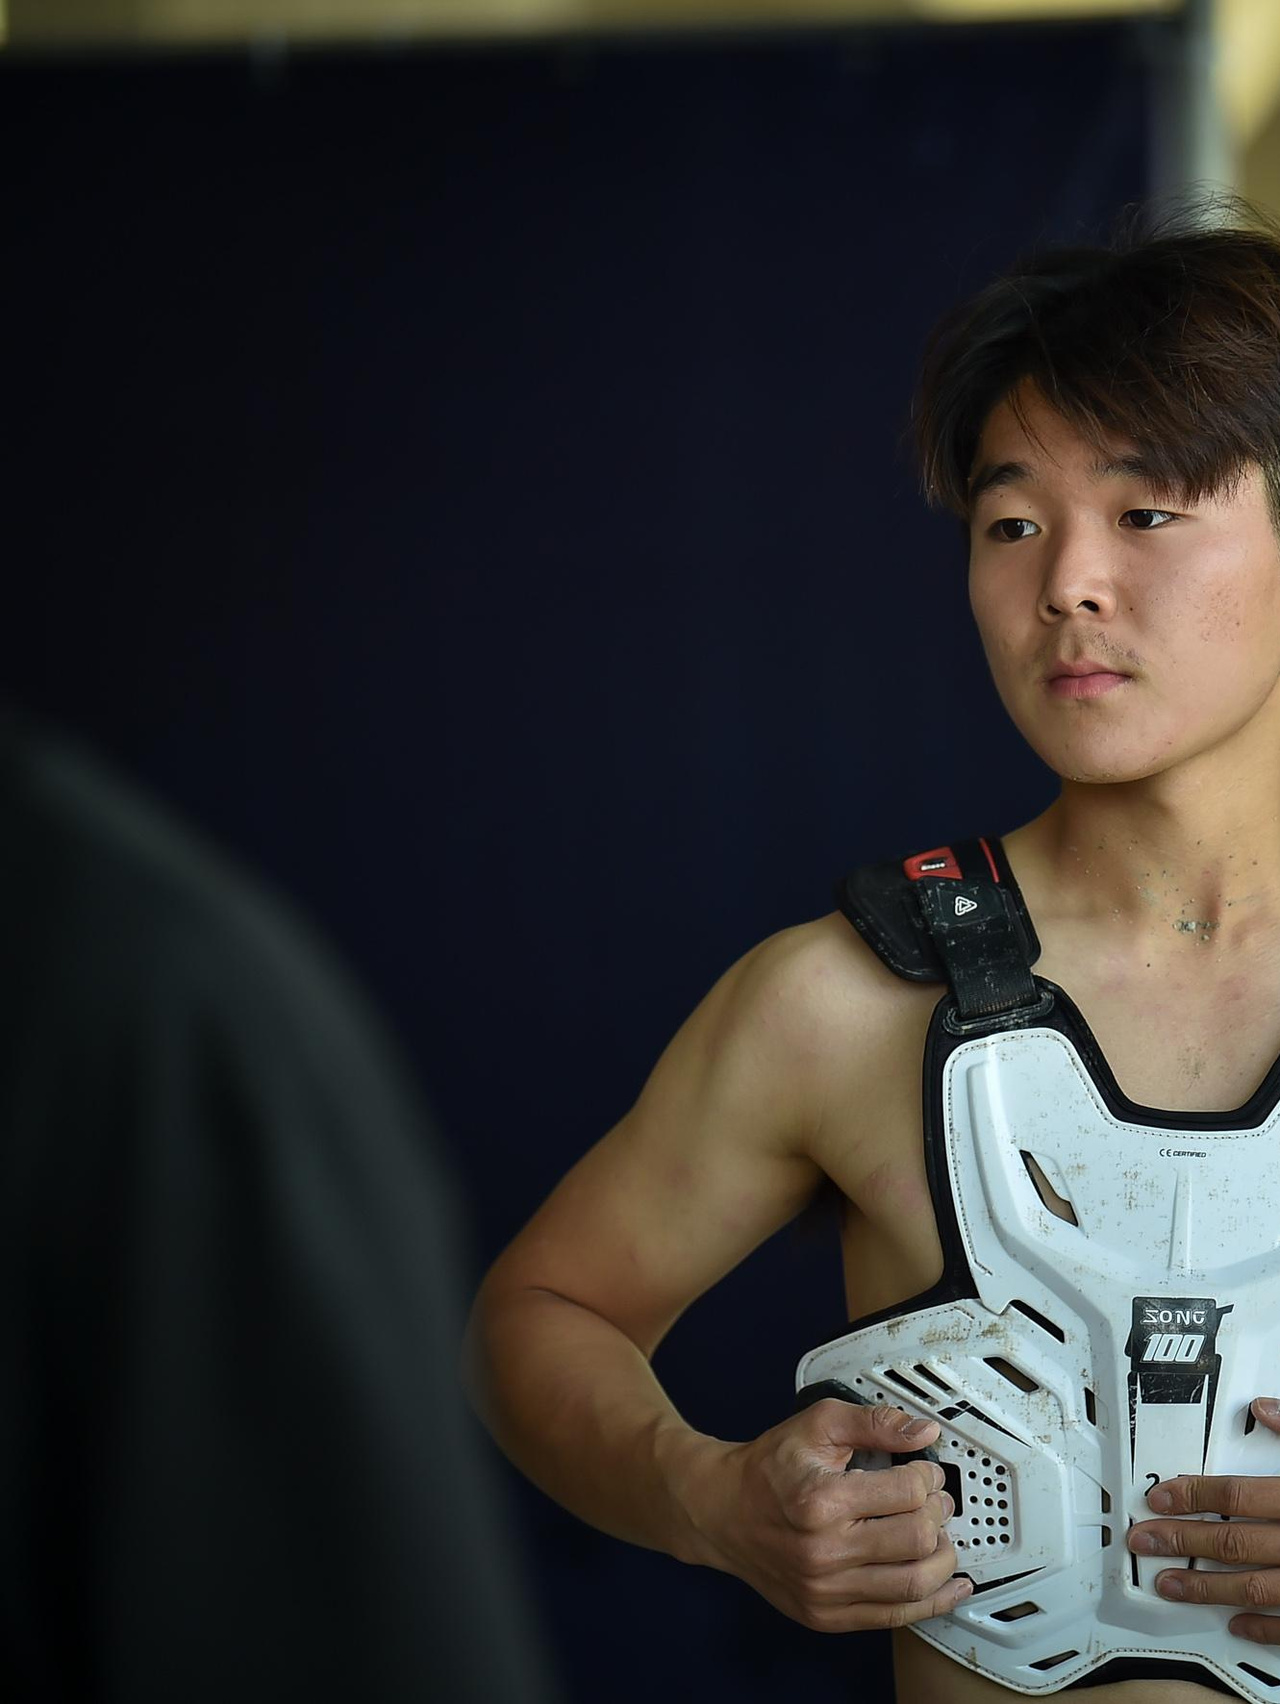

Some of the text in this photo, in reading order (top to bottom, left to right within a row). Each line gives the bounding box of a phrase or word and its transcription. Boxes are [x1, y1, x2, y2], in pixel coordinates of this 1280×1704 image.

[1159, 1148, 1207, 1158] CE CERTIFIED
[1140, 1332, 1206, 1363] 100
